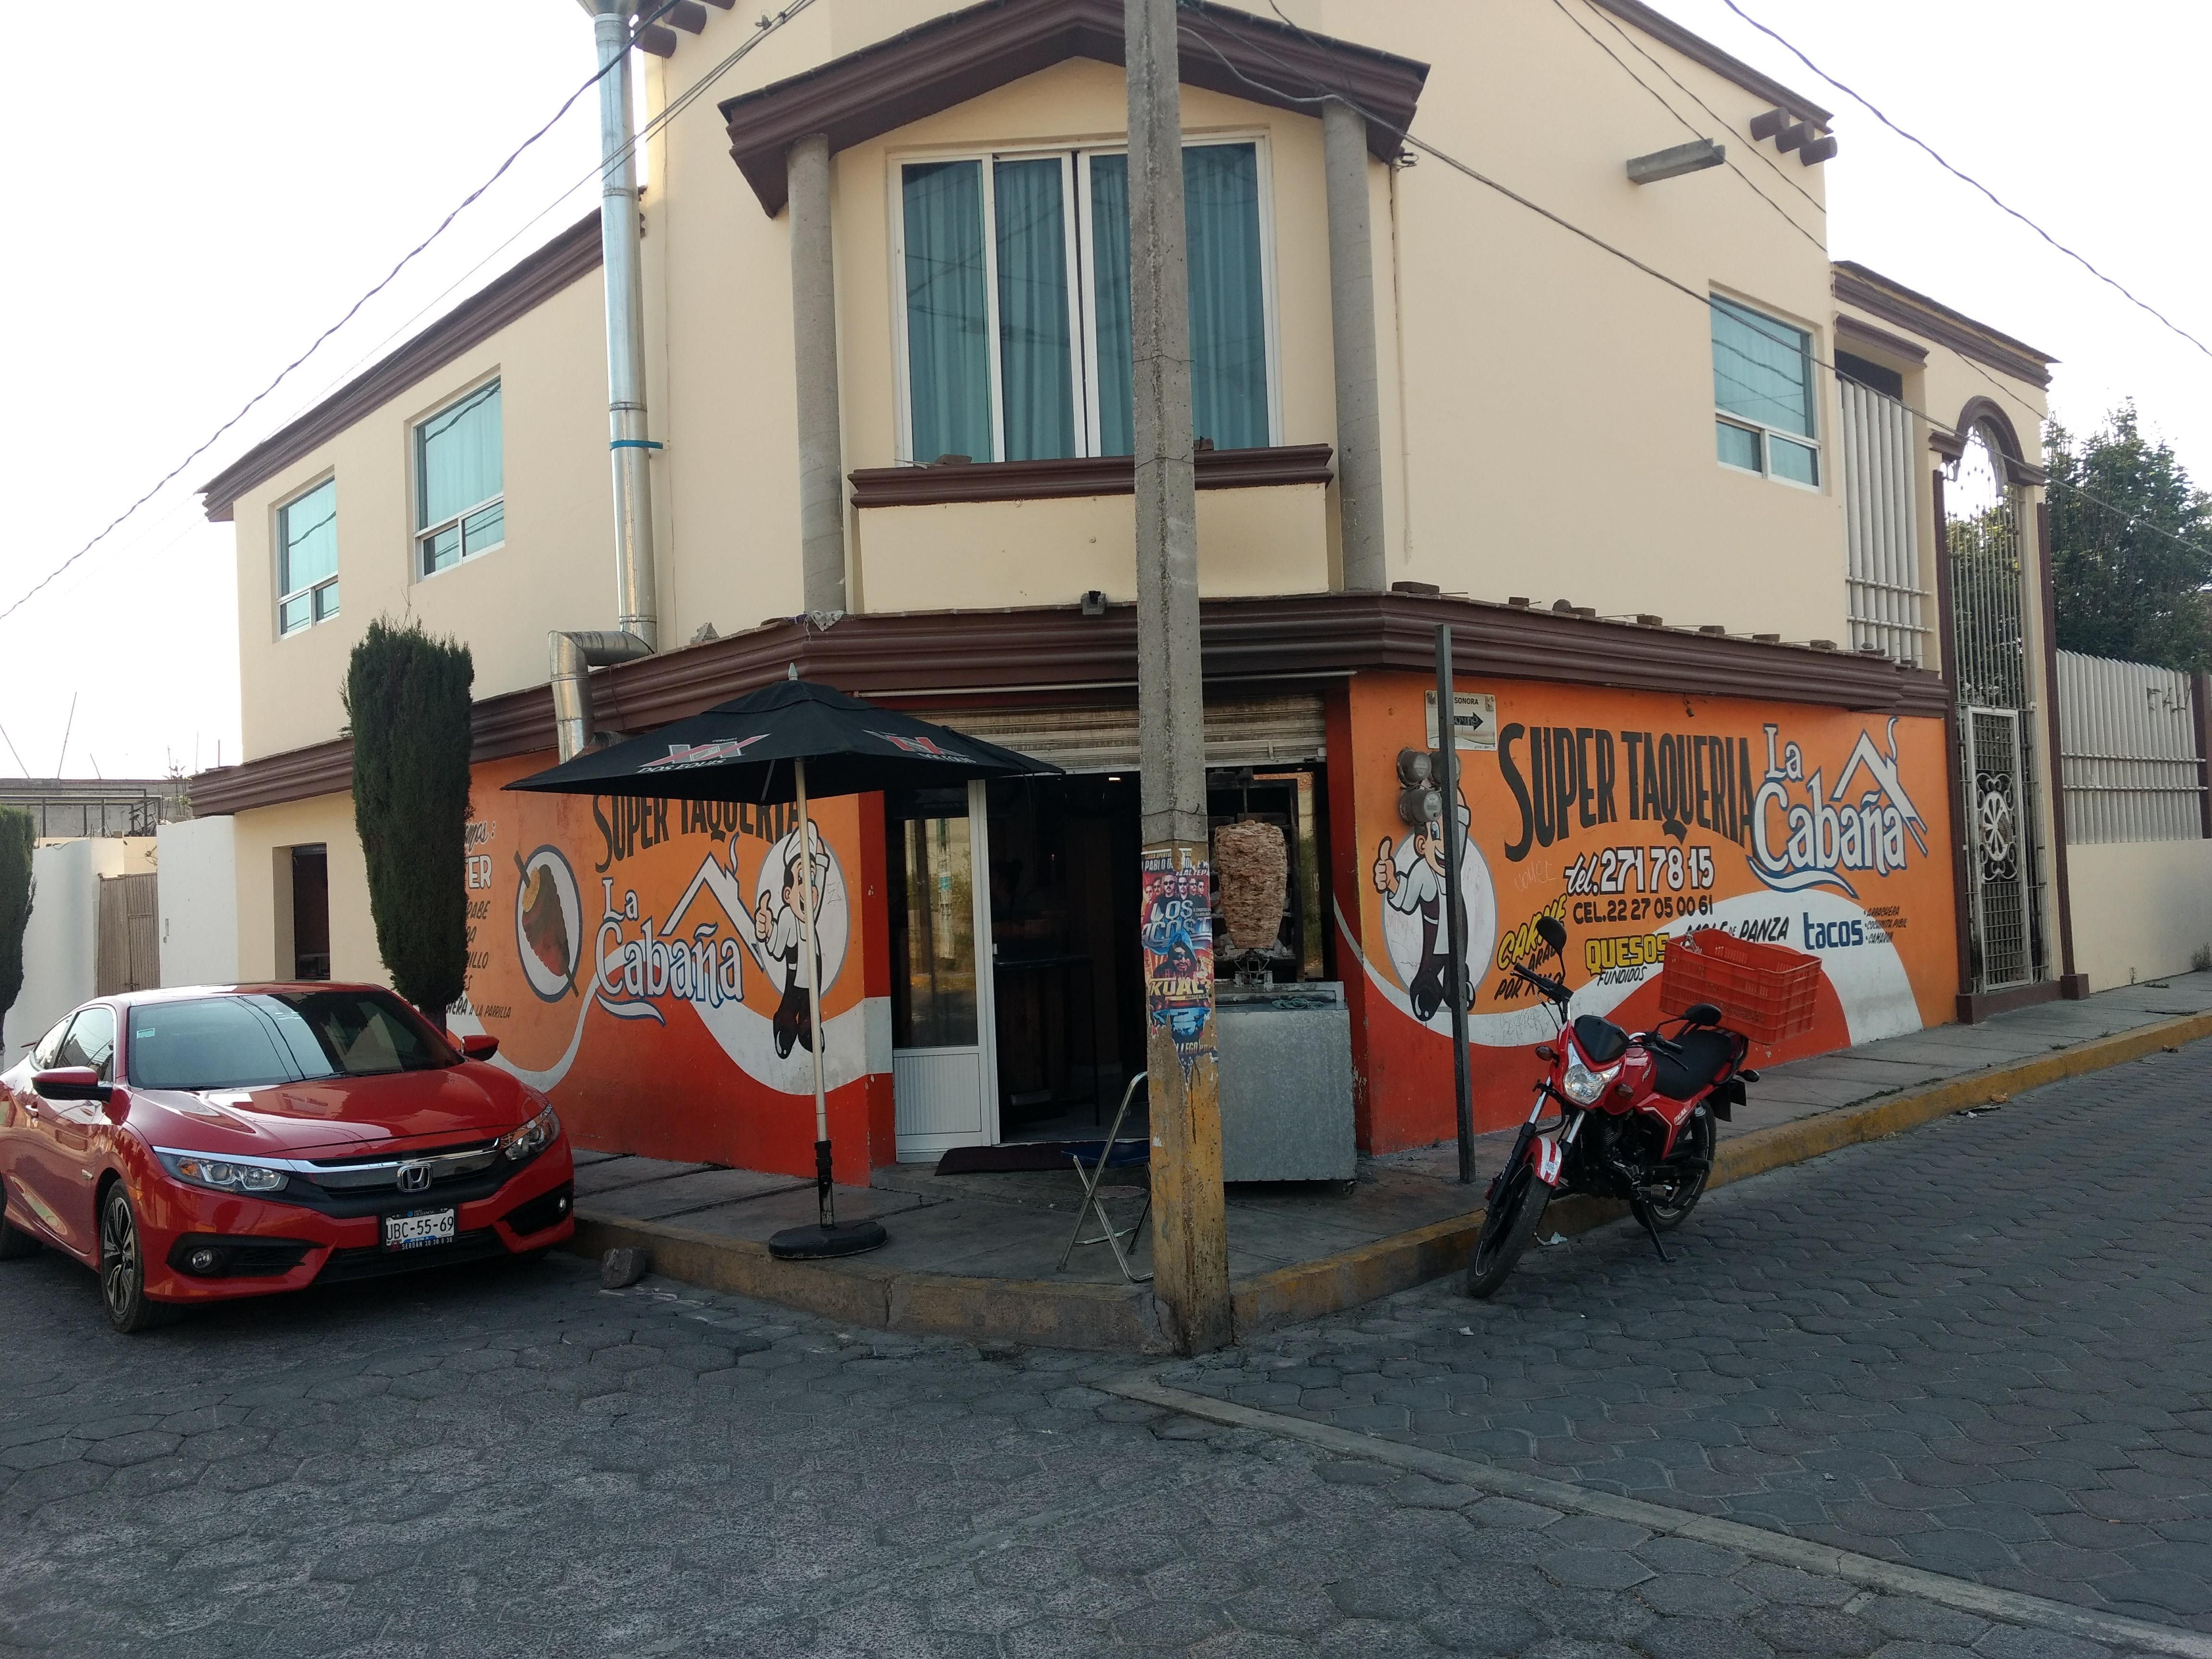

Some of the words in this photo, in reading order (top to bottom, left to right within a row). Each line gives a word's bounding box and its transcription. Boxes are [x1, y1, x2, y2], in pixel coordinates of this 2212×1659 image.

[1454, 697, 1479, 705] SONORA
[1763, 723, 1804, 783] La
[636, 764, 673, 774] DOS
[673, 758, 727, 770] EQUIS
[1498, 722, 1618, 863] SUPER
[1621, 730, 1759, 861] TAQUERIA
[592, 794, 670, 873] SUPER
[1754, 766, 1907, 878] Cabaña
[1144, 858, 1166, 872] PABLO
[601, 876, 639, 922] La
[1150, 900, 1193, 922] LOS
[1142, 916, 1212, 941] ACOST
[1739, 916, 1790, 943] PANZA
[1803, 912, 1863, 950] tacos
[595, 914, 744, 1009] Cabaña
[1585, 932, 1670, 977] QUESOS
[1597, 966, 1647, 986] FUNDIDOS
[1494, 978, 1522, 1000] POR
[469, 1004, 474, 1016] A
[475, 1004, 483, 1017] LA
[484, 1005, 511, 1019] PARRILLA
[386, 1216, 454, 1240] UBC-55-69
[402, 1241, 423, 1250] SERDAN
